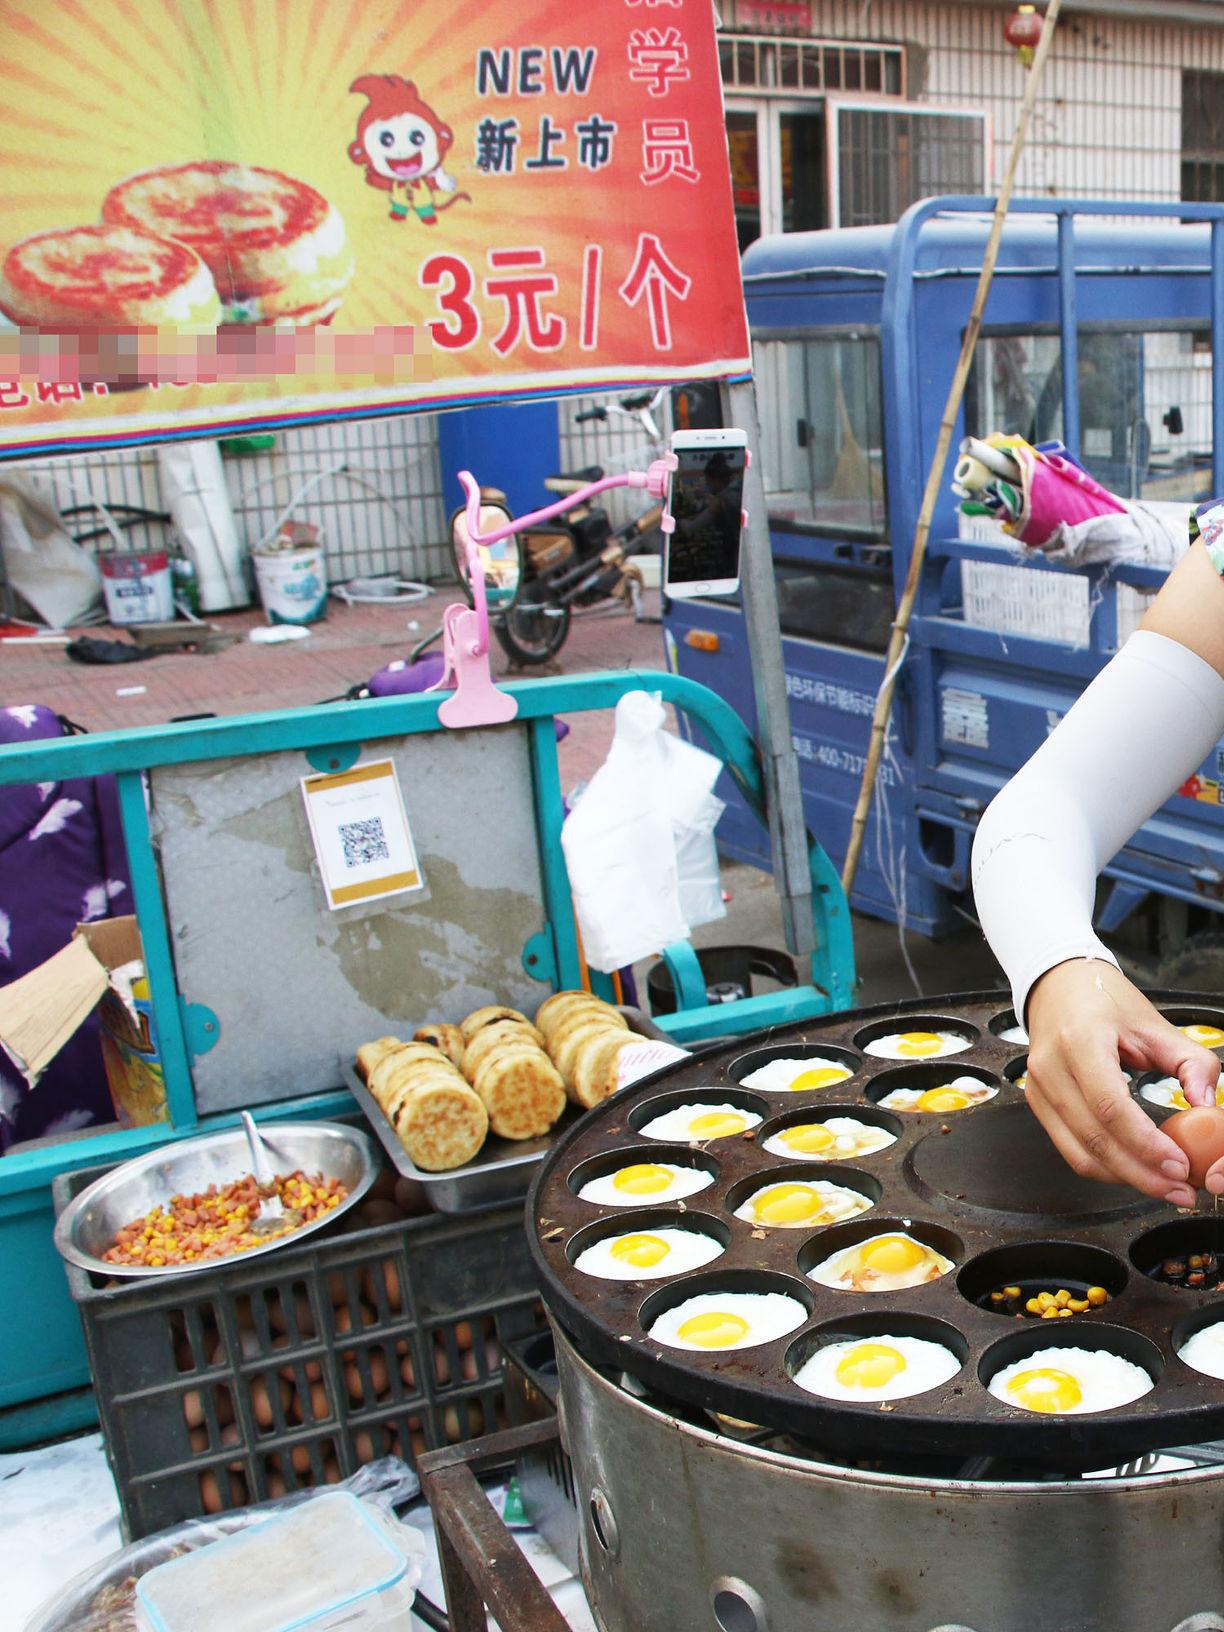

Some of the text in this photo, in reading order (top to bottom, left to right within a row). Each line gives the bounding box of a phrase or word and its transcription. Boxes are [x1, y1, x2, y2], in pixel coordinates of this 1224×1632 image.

[477, 47, 596, 95] NEW
[625, 0, 700, 185] 学员
[476, 115, 616, 173] 新上市
